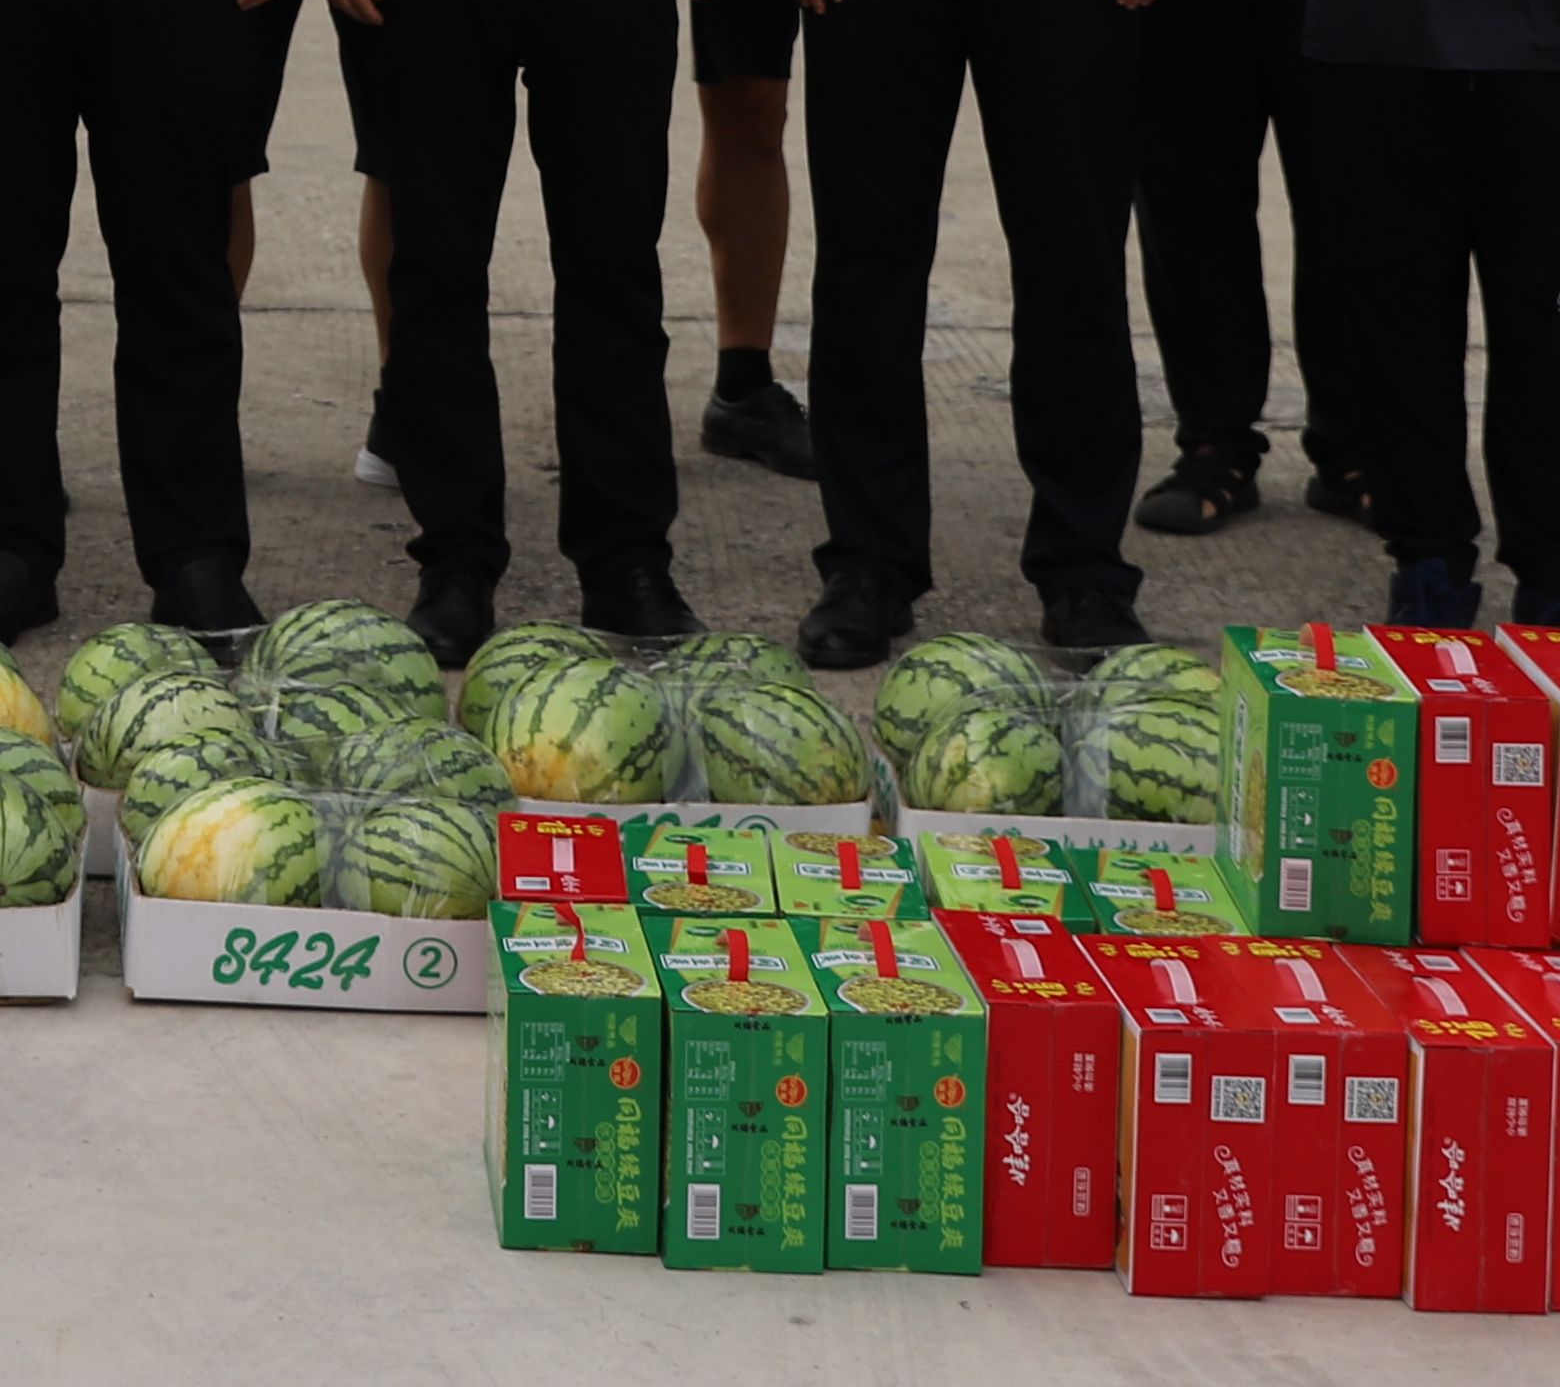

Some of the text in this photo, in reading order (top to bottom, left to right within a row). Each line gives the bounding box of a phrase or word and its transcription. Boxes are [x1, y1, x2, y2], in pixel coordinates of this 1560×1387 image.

[211, 926, 381, 991] 8424
[1003, 1094, 1030, 1186] 娃哈哈
[1437, 1141, 1466, 1232] 娃哈哈
